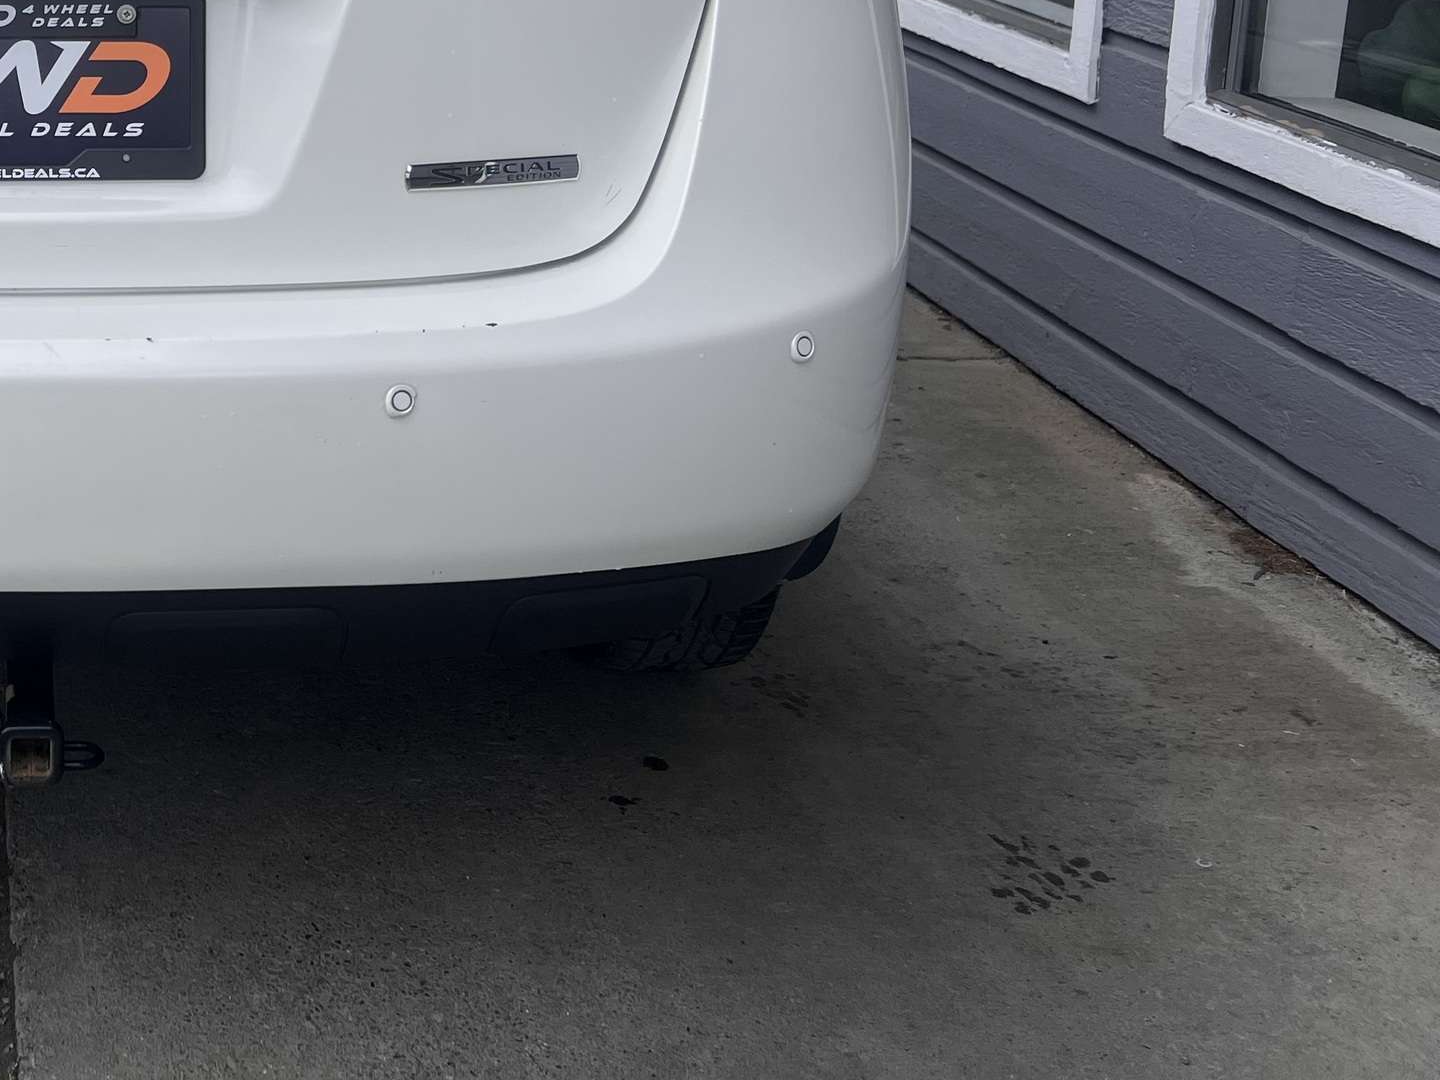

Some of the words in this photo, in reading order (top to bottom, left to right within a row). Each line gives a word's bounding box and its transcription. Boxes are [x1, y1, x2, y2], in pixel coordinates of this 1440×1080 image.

[22, 4, 35, 15] 4
[44, 4, 114, 15] WHEEL
[32, 17, 105, 28] DEALS
[30, 122, 145, 138] DEALS
[431, 160, 561, 185] SPECIAL
[506, 171, 561, 182] EDITION
